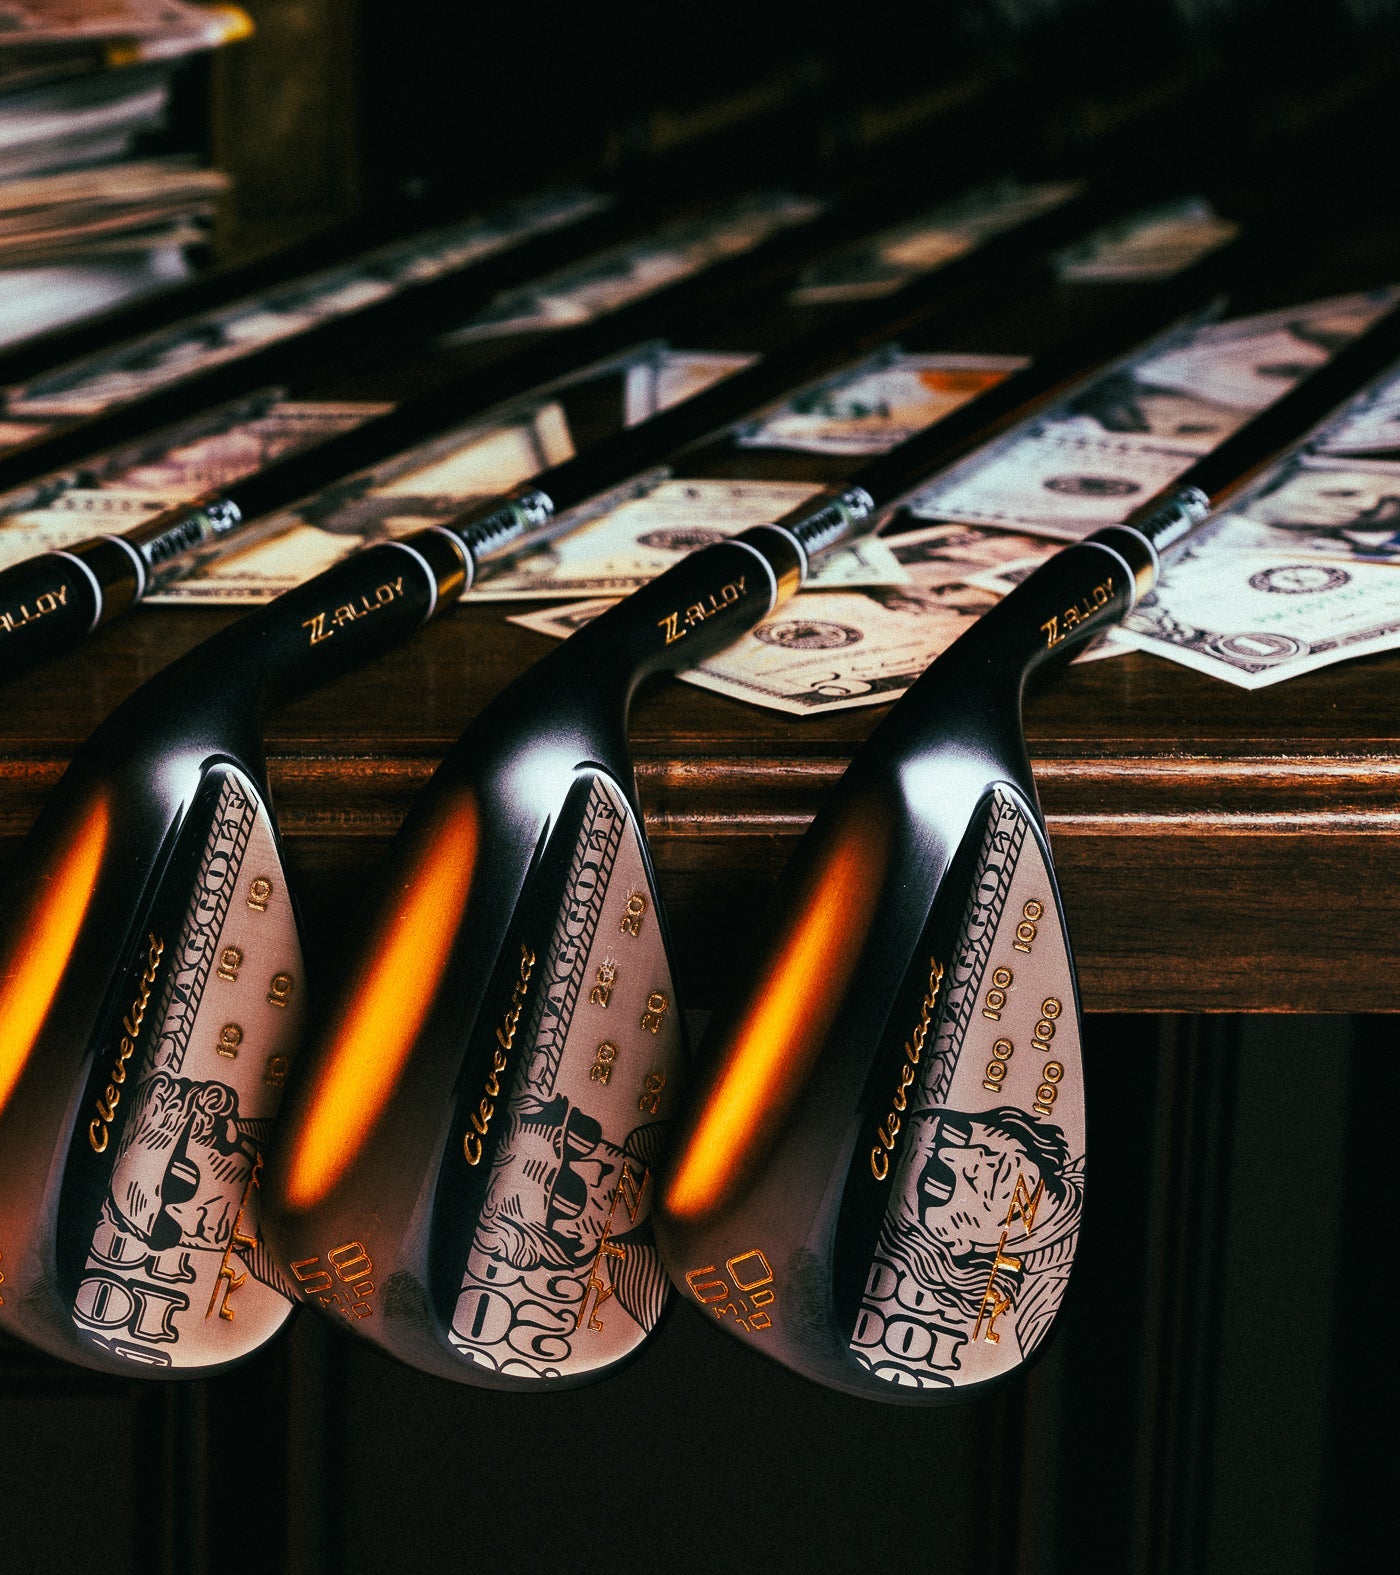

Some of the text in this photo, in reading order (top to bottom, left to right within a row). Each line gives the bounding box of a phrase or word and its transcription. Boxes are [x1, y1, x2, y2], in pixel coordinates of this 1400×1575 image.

[246, 876, 274, 913] 10
[619, 891, 647, 937] 20
[1012, 898, 1044, 954] 100
[216, 945, 244, 983] 10
[266, 971, 294, 1007] 10
[589, 960, 618, 1008] 20
[639, 990, 669, 1034] 20
[982, 965, 1014, 1021] 100
[89, 931, 164, 1152] Cleveland
[215, 1022, 244, 1060] 10
[1031, 996, 1063, 1052] 100
[463, 943, 536, 1166] Cleveland
[589, 1040, 618, 1085] 20
[871, 955, 944, 1181] Cleveland
[982, 1037, 1015, 1093] 100
[1032, 1060, 1065, 1116] 100
[289, 1240, 374, 1295] 58
[685, 1248, 774, 1304] 60
[73, 1275, 191, 1343] 10
[318, 1280, 375, 1309] MID
[340, 1301, 374, 1321] 10
[711, 1289, 775, 1319] MID
[451, 1285, 579, 1362] 20
[735, 1310, 773, 1332] 10
